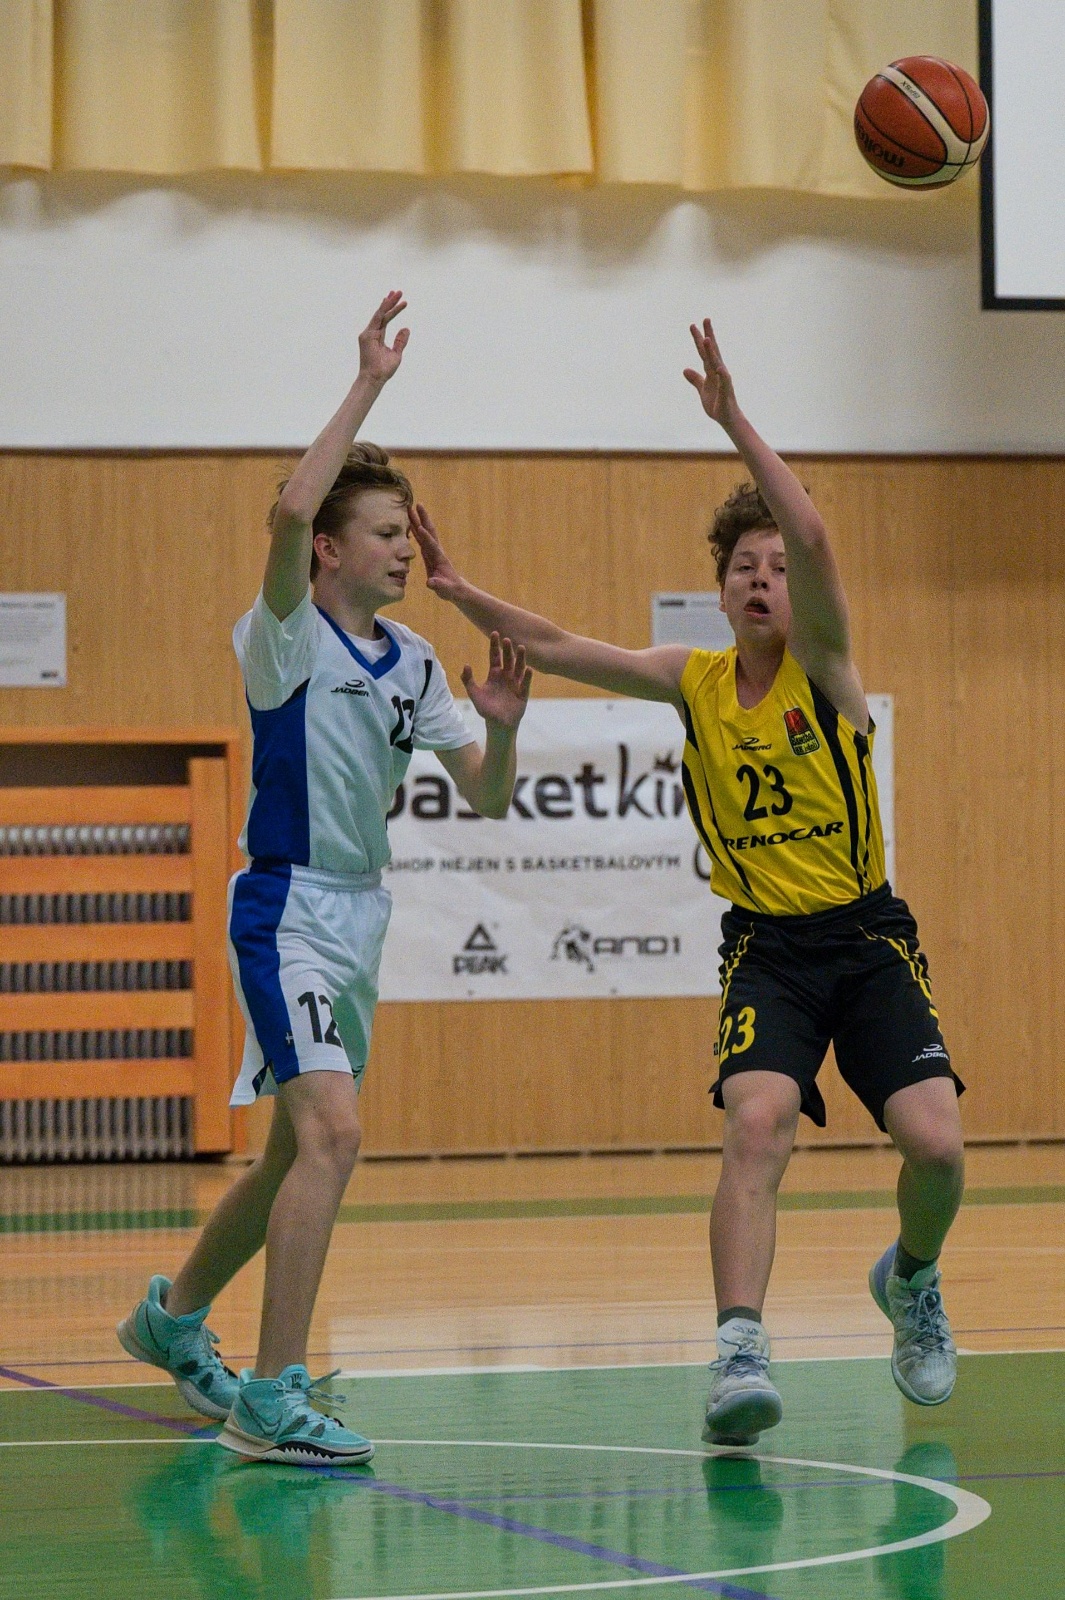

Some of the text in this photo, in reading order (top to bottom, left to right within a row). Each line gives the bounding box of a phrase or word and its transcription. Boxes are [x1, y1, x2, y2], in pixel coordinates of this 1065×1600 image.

[735, 763, 793, 822] 23
[724, 821, 844, 851] RENOCAR
[453, 954, 508, 975] PEAK
[297, 991, 344, 1049] 12
[719, 1006, 756, 1066] 23
